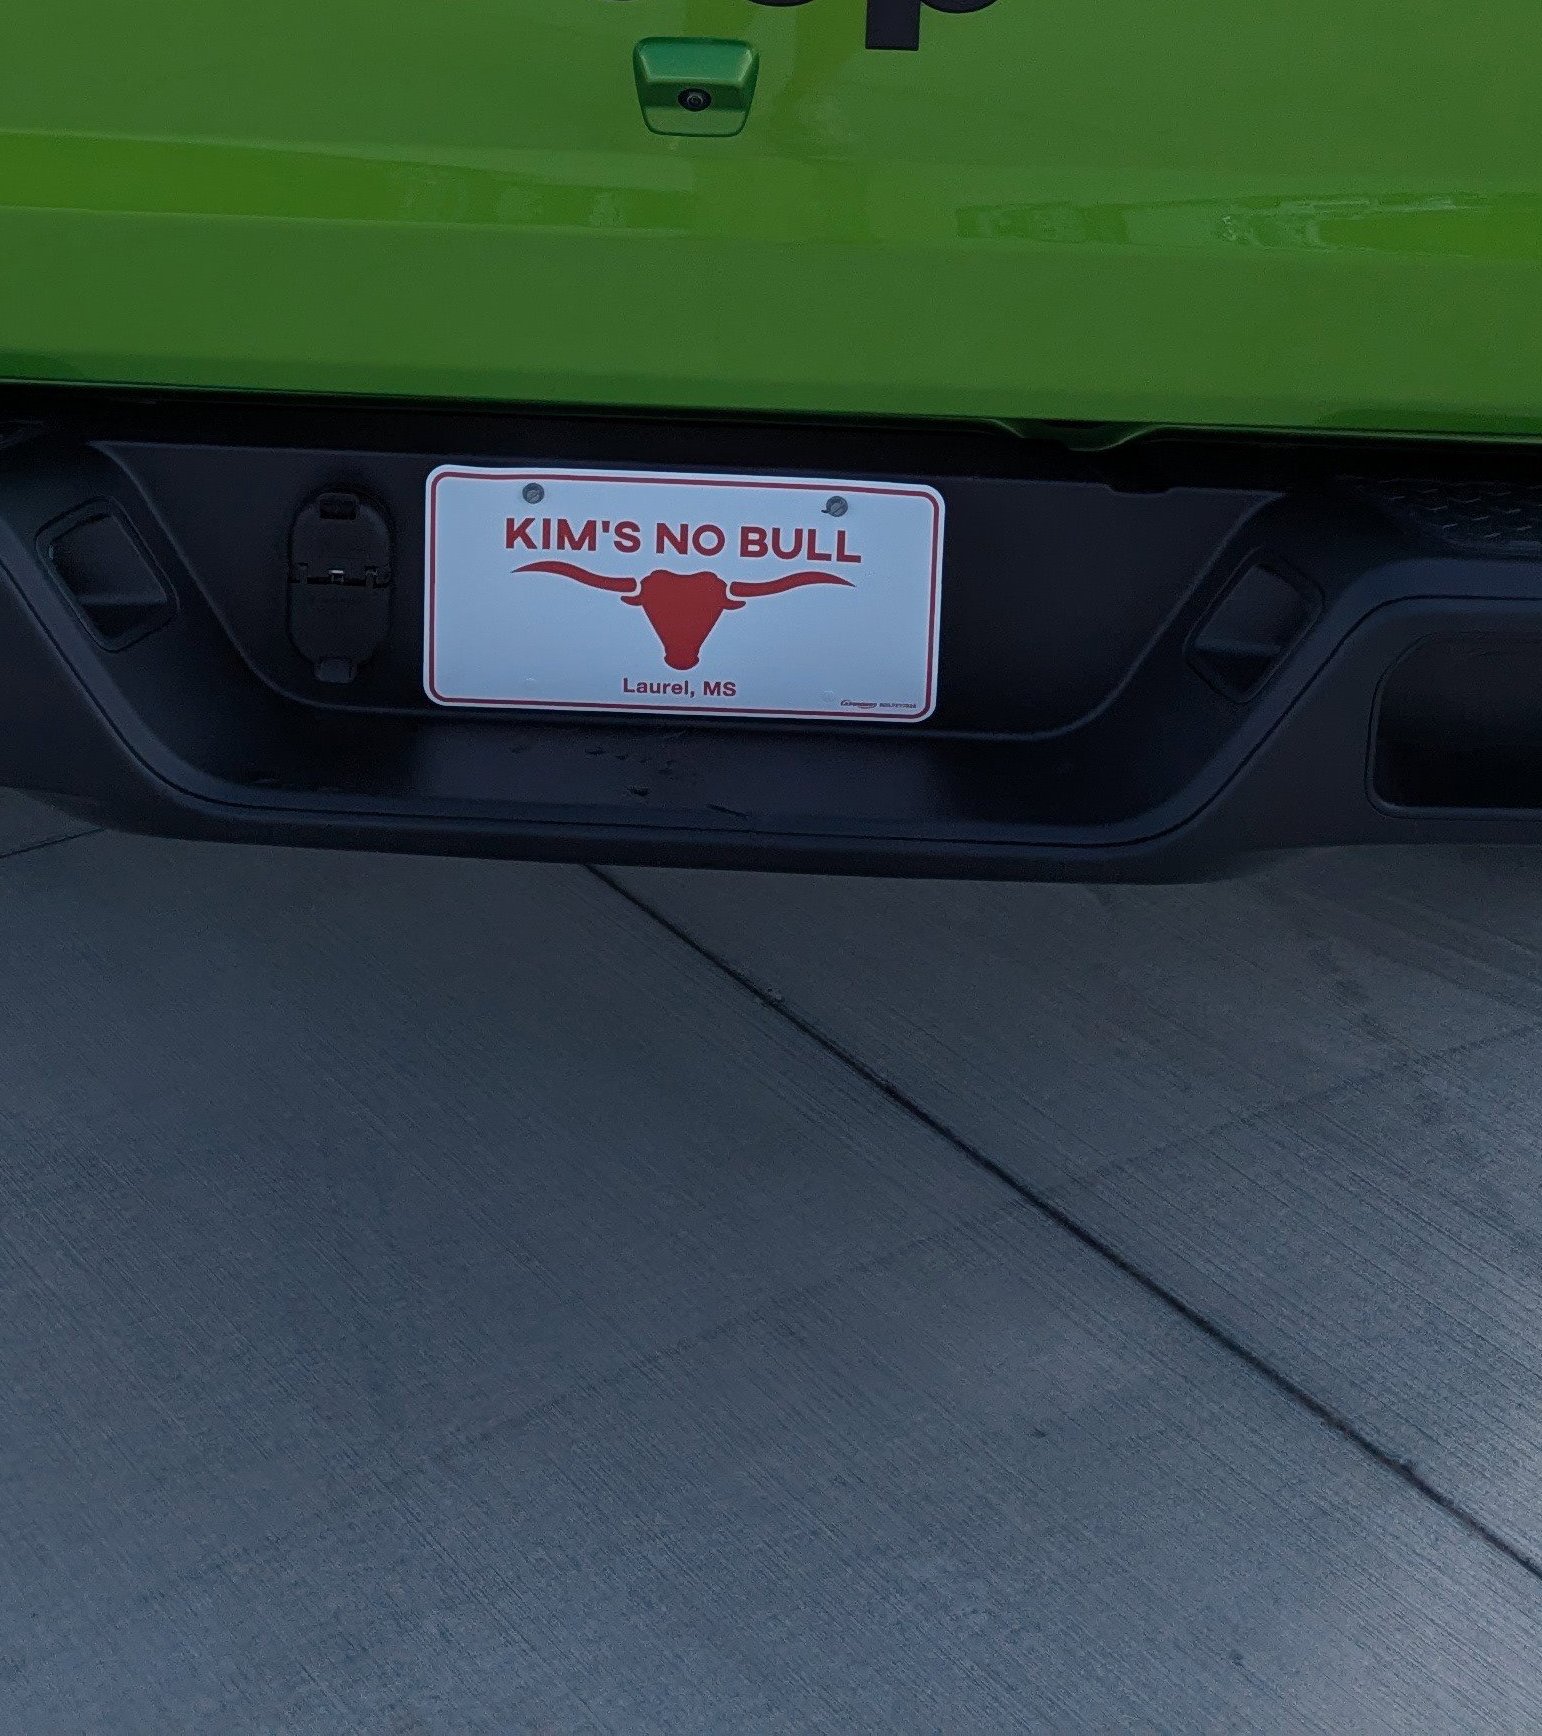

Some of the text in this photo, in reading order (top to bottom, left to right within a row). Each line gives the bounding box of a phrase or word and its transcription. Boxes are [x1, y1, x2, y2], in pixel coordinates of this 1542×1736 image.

[505, 517, 862, 564] KIM'S NO BULL
[622, 677, 737, 699] Laurel, MS
